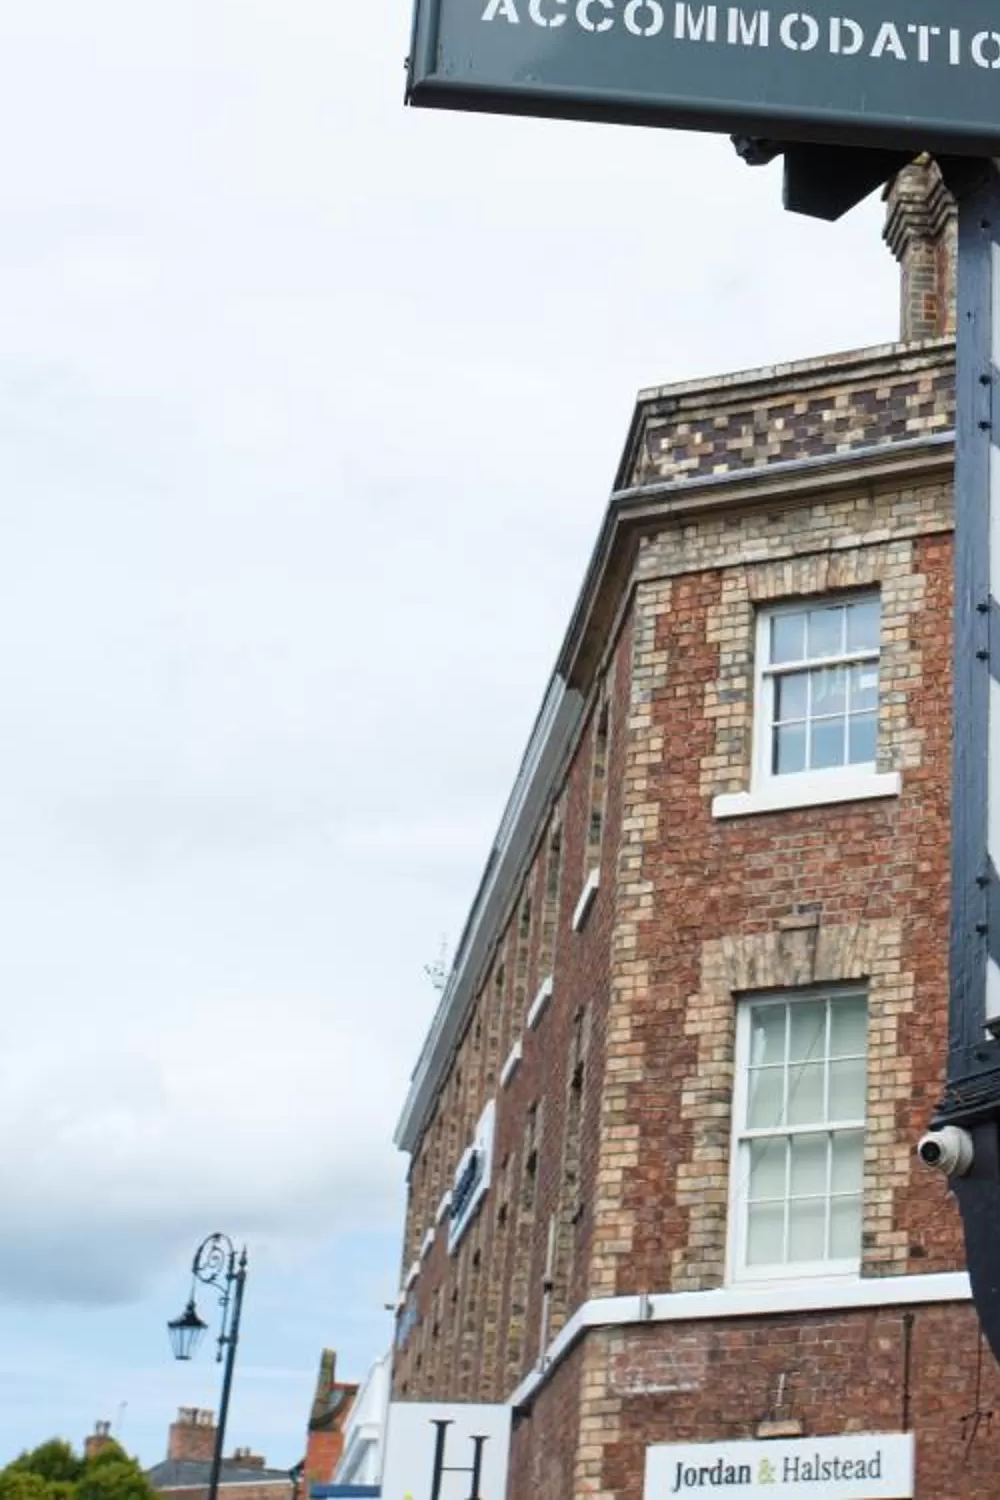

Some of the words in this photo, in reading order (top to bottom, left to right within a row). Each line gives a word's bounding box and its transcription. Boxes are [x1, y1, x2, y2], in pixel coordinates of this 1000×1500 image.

[672, 1458, 751, 1493] Jordan
[758, 1456, 775, 1484] &
[783, 1450, 882, 1483] Halstead
